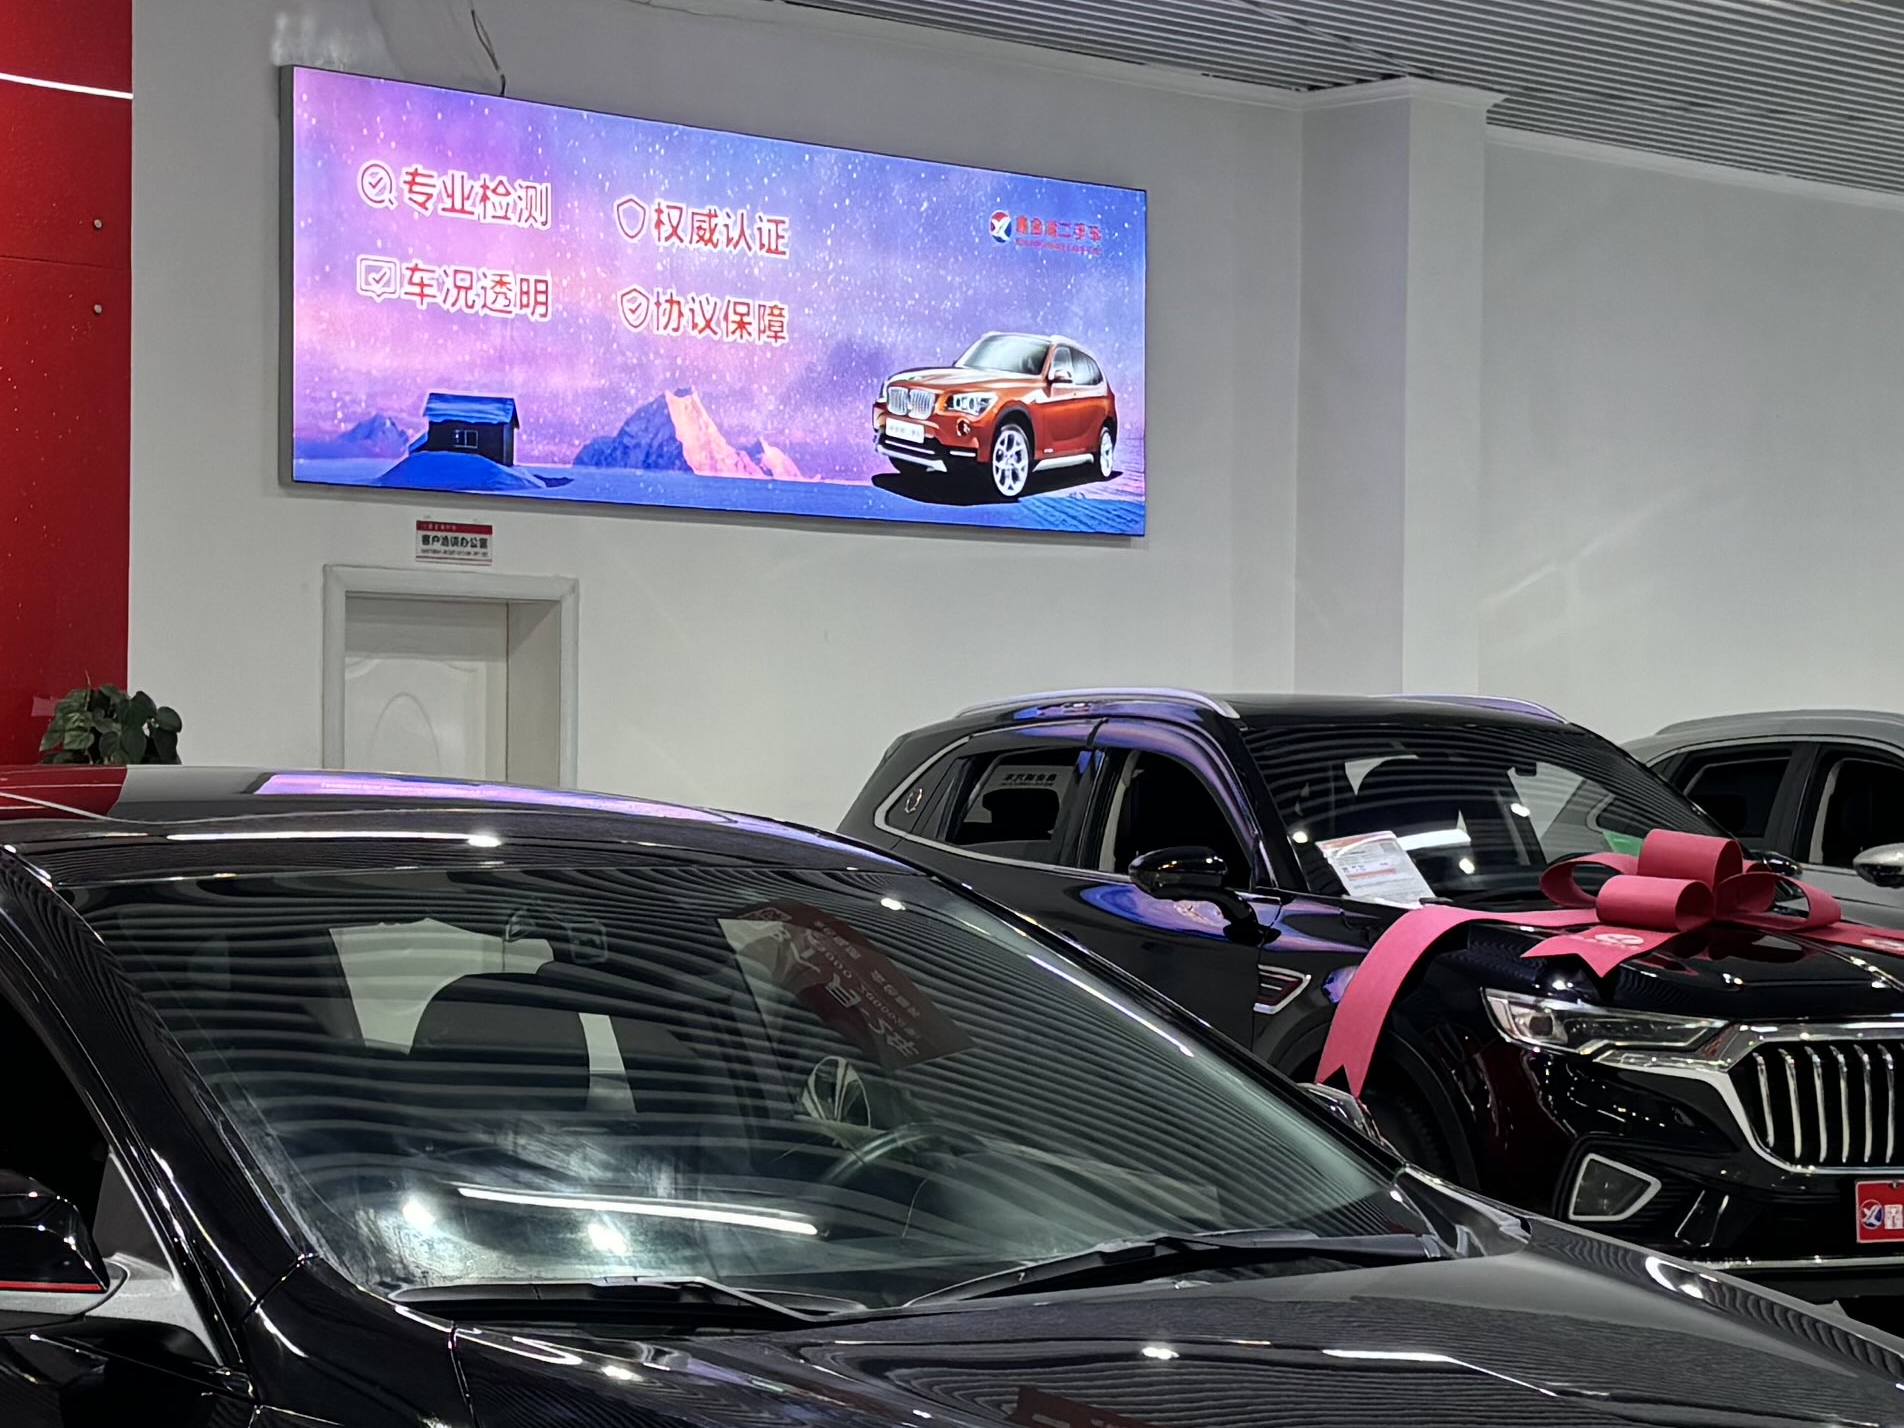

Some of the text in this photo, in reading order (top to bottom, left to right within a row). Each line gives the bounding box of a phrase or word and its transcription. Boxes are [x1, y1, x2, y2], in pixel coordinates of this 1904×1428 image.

[402, 166, 789, 258] 专业检测 权威认证
[402, 263, 789, 343] 车况透明 协议保障
